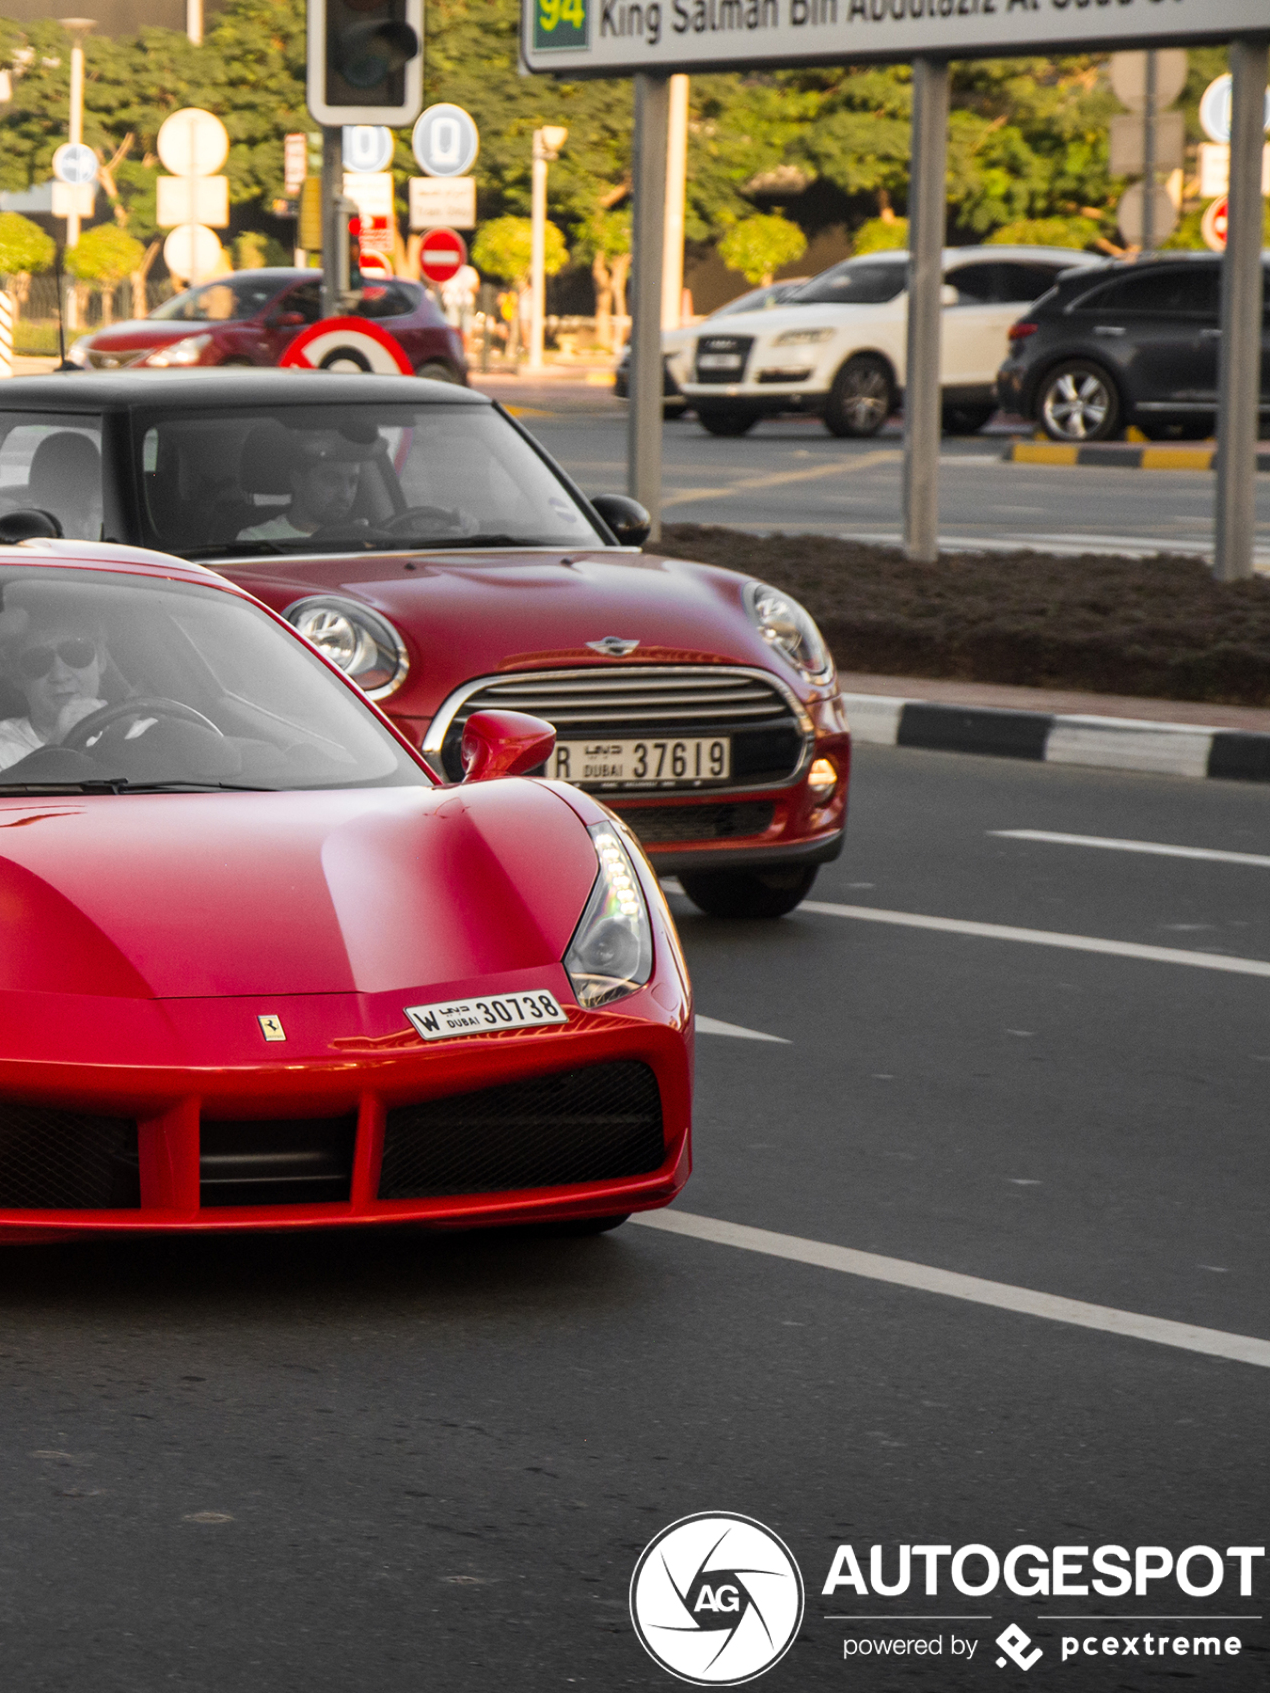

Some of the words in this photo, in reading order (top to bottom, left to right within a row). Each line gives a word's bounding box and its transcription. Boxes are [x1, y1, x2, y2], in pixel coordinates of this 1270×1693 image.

[539, 0, 584, 31] 94
[598, 0, 661, 44] King
[672, 0, 779, 33] Salman
[556, 746, 571, 778] R
[583, 764, 624, 778] DUBAI
[633, 740, 726, 779] 37619
[412, 1010, 441, 1032] W
[446, 1018, 480, 1029] DUBAI
[475, 995, 559, 1024] 30738
